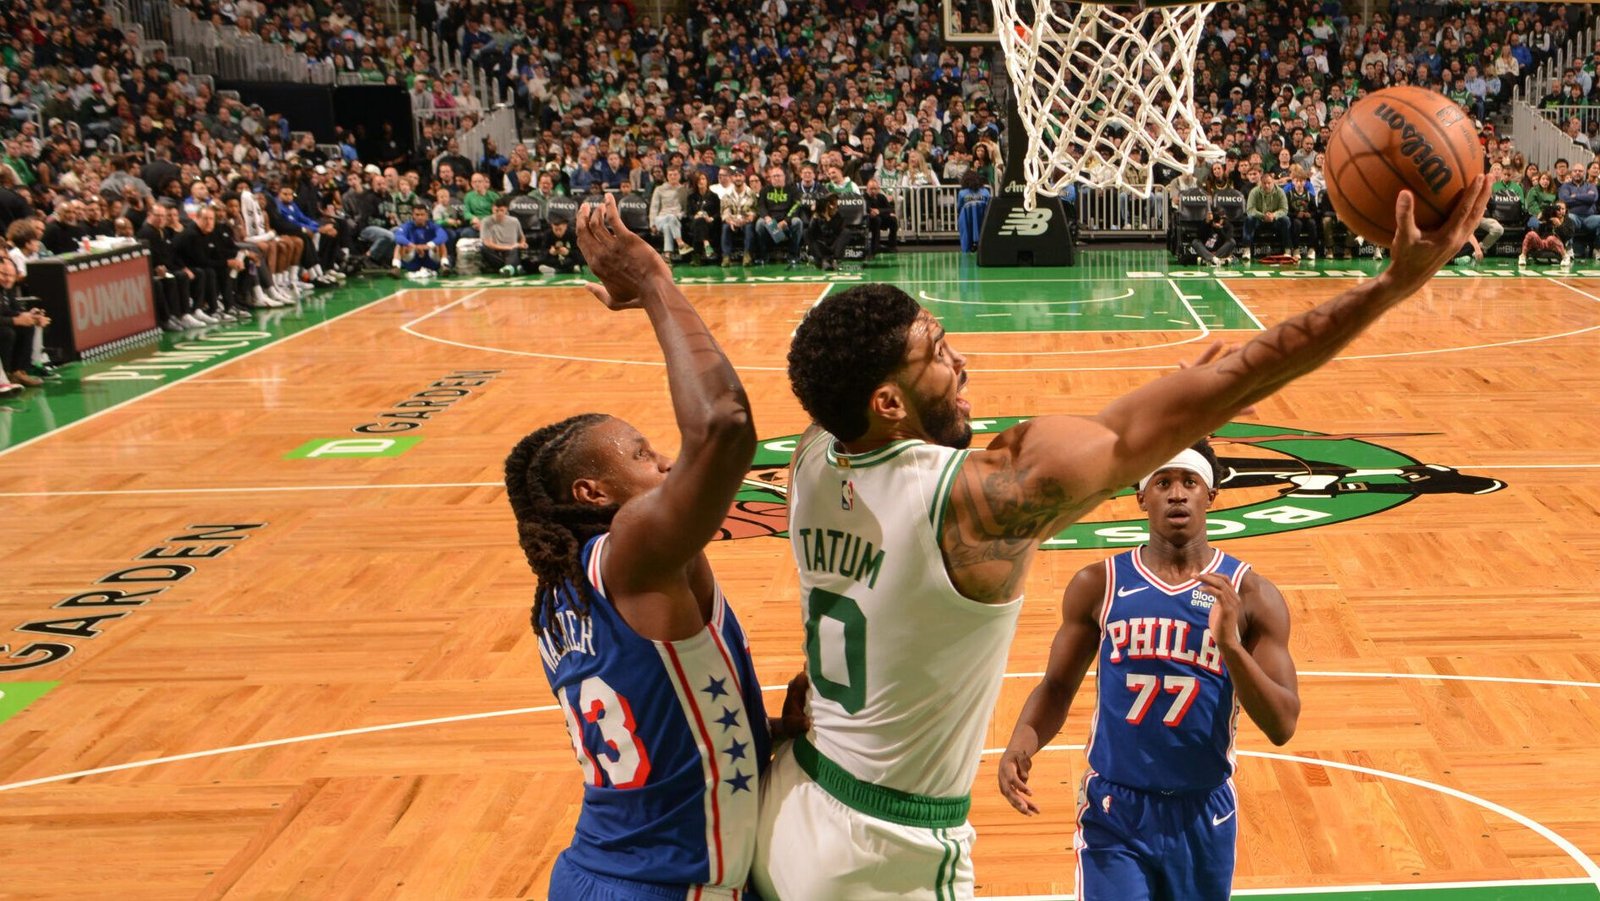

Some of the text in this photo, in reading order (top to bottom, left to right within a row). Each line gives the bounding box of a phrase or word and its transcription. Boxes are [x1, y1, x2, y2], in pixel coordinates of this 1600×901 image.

[1374, 103, 1452, 194] Wilson
[621, 201, 648, 209] PIMCO
[73, 274, 148, 331] DUNKIN'
[83, 331, 272, 381] PIMCO
[352, 370, 502, 433] GARDEN
[800, 528, 885, 589] TATUM
[0, 522, 268, 672] GARDEN
[1191, 600, 1212, 608] ener
[1192, 590, 1216, 602] Bloo
[806, 587, 867, 715] 0
[1107, 618, 1223, 675] PHILA
[1125, 674, 1199, 727] 77
